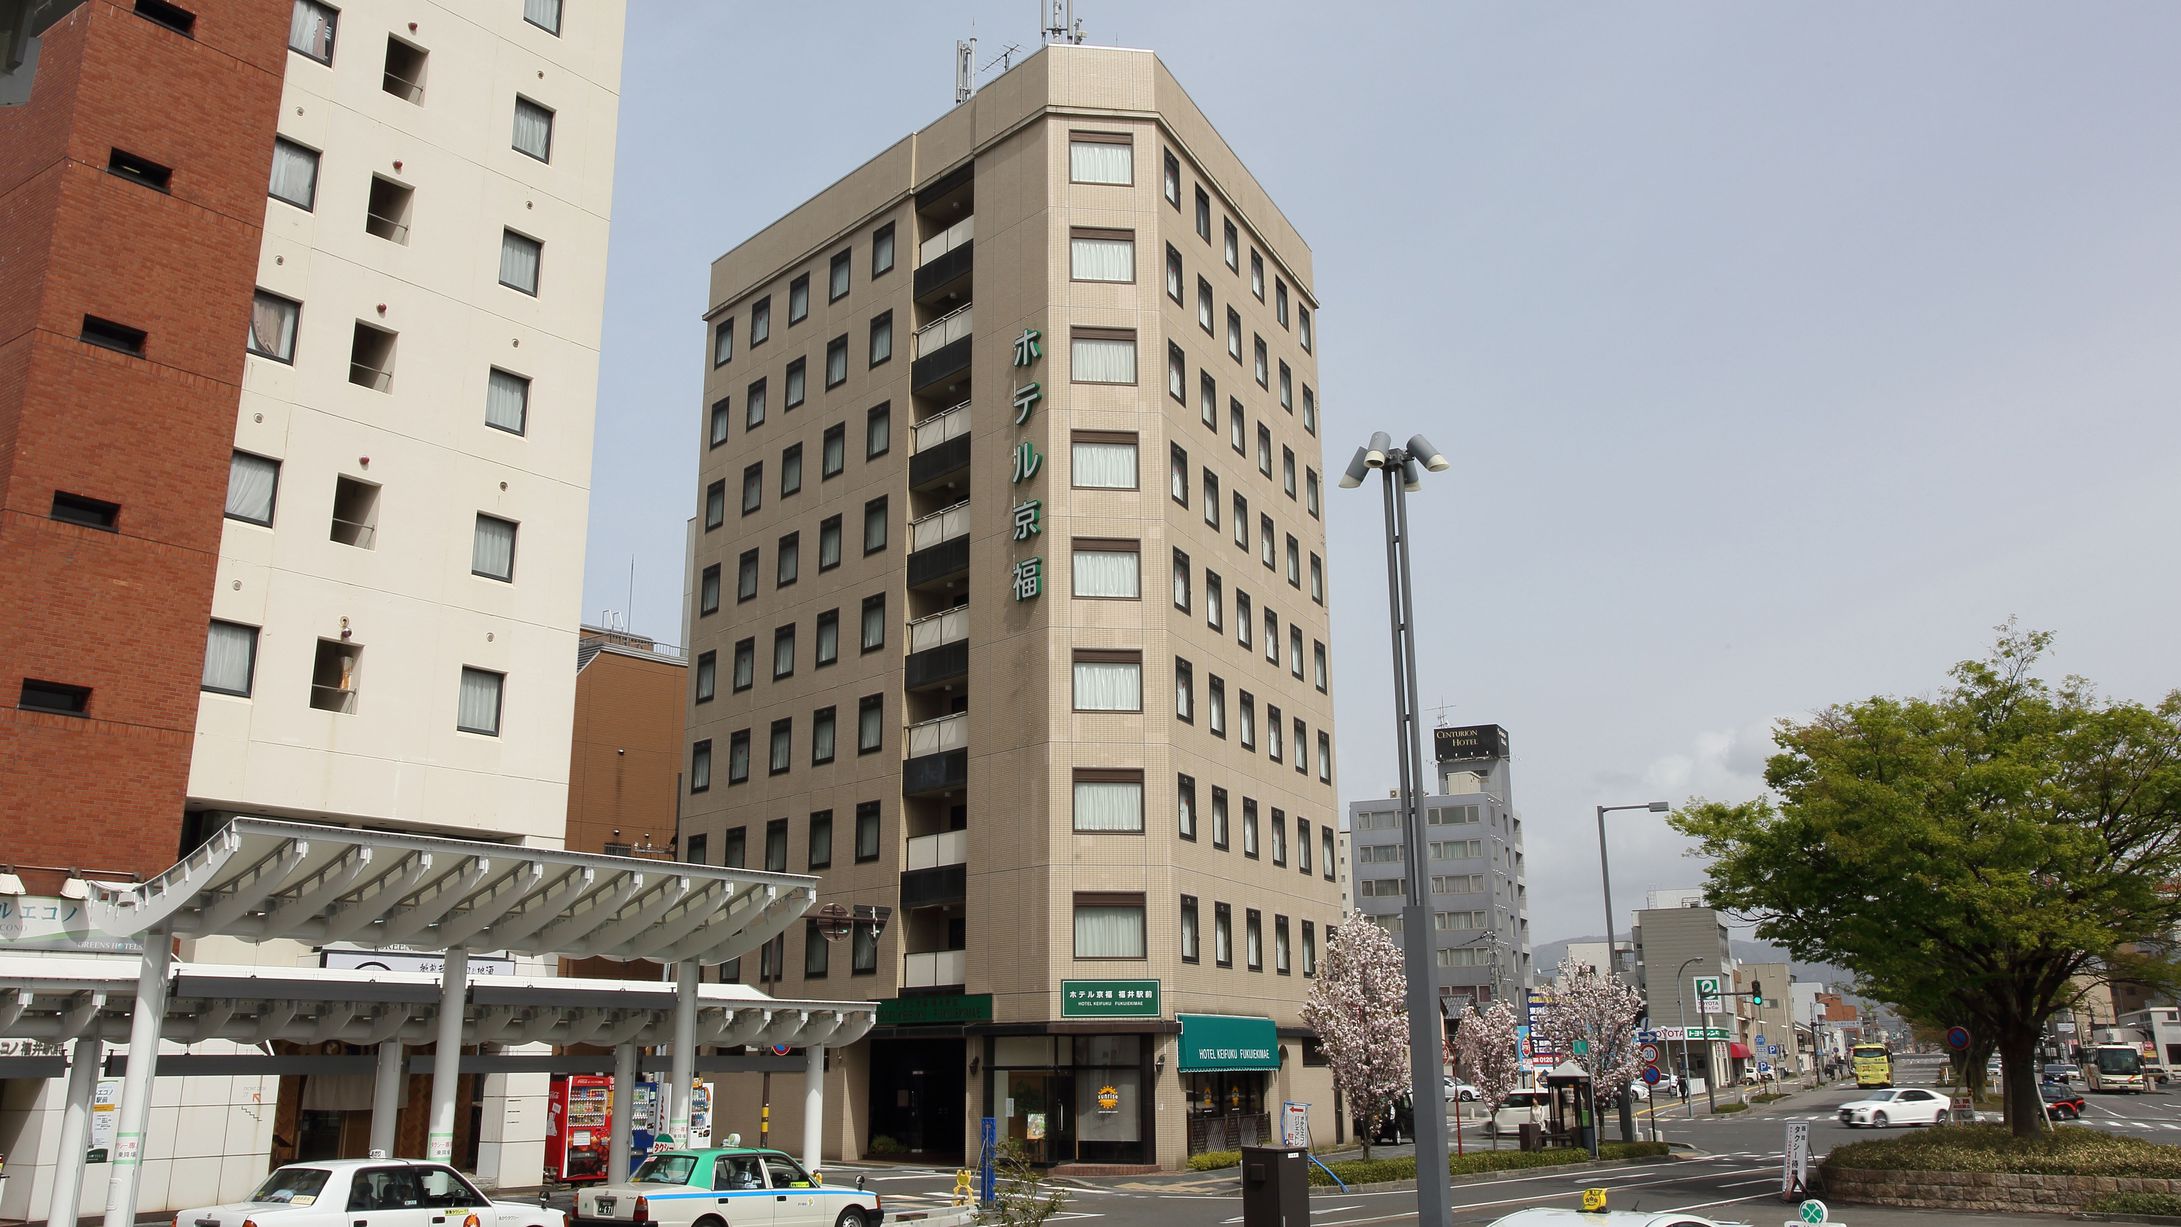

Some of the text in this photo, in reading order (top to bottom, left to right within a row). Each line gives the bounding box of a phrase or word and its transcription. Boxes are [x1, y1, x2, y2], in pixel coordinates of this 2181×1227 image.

[1013, 329, 1043, 601] ホテル京福
[1436, 729, 1478, 739] CENTURION
[1452, 738, 1478, 747] HOTEL
[1069, 990, 1153, 999] ホテル京福 福井駅前
[1199, 1048, 1216, 1059] HOTEL
[1217, 1048, 1238, 1059] KEIFUKU
[1769, 1046, 1775, 1054] P
[1644, 1051, 1654, 1059] 30
[1760, 1062, 1767, 1070] P
[654, 1142, 674, 1152] タクシー
